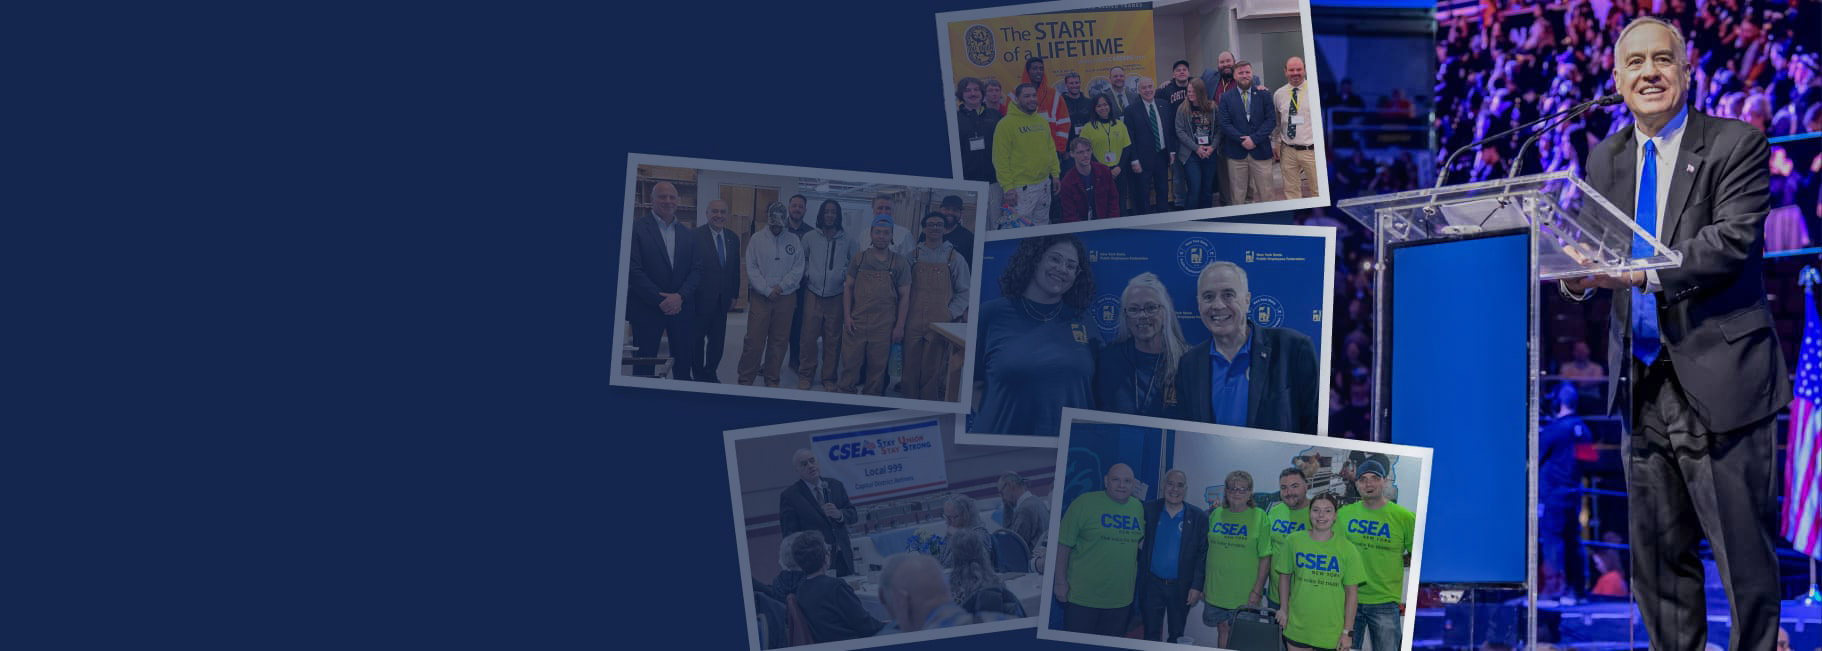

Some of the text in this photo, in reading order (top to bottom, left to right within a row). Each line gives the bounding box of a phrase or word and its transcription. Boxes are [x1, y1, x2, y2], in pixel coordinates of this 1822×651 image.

[1000, 20, 1097, 42] The START
[1003, 46, 1020, 62] of
[1024, 50, 1033, 61] a
[1036, 37, 1124, 60] LIFETIME
[829, 442, 876, 461] CSEA
[864, 465, 886, 477] Local
[1101, 513, 1141, 531] CSEA
[1212, 522, 1248, 537] CSEA
[1272, 519, 1305, 535] CSEA
[1347, 518, 1391, 538] CSEA
[1295, 551, 1340, 573] CSEA
